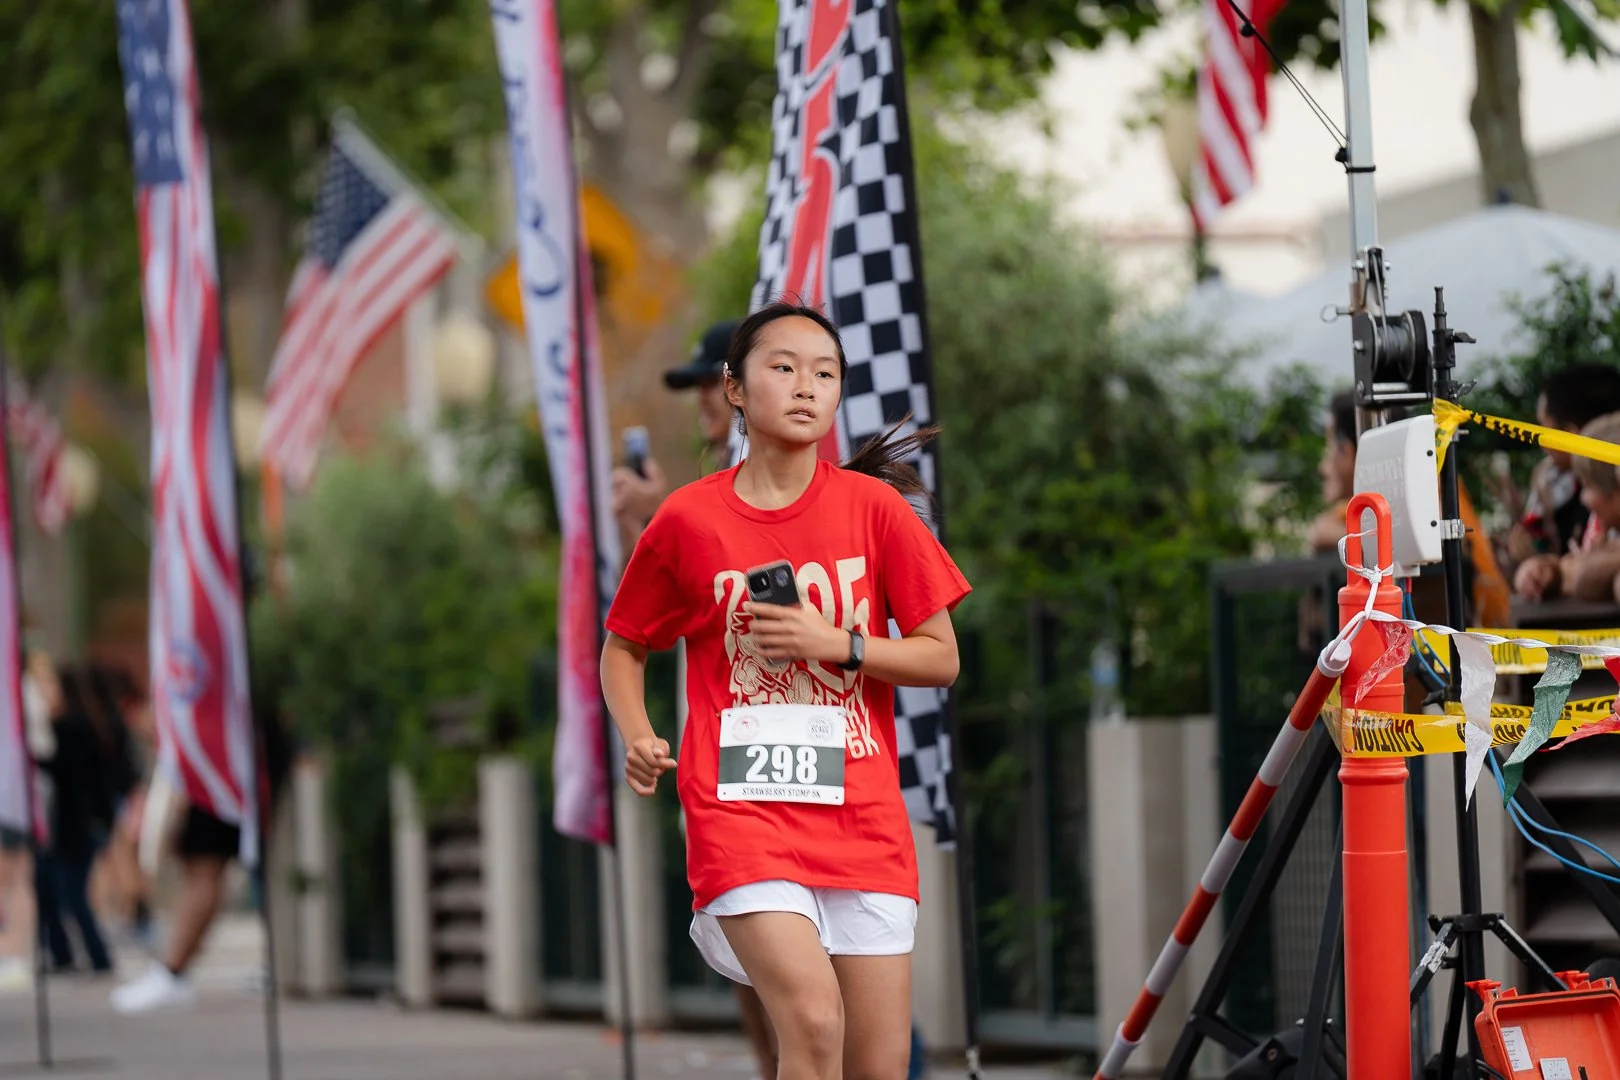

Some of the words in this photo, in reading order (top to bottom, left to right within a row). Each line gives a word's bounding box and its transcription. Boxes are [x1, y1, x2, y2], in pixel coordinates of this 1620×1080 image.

[1352, 716, 1425, 752] CAUTION
[745, 745, 818, 785] 298
[742, 786, 786, 797] STRAWBERRY
